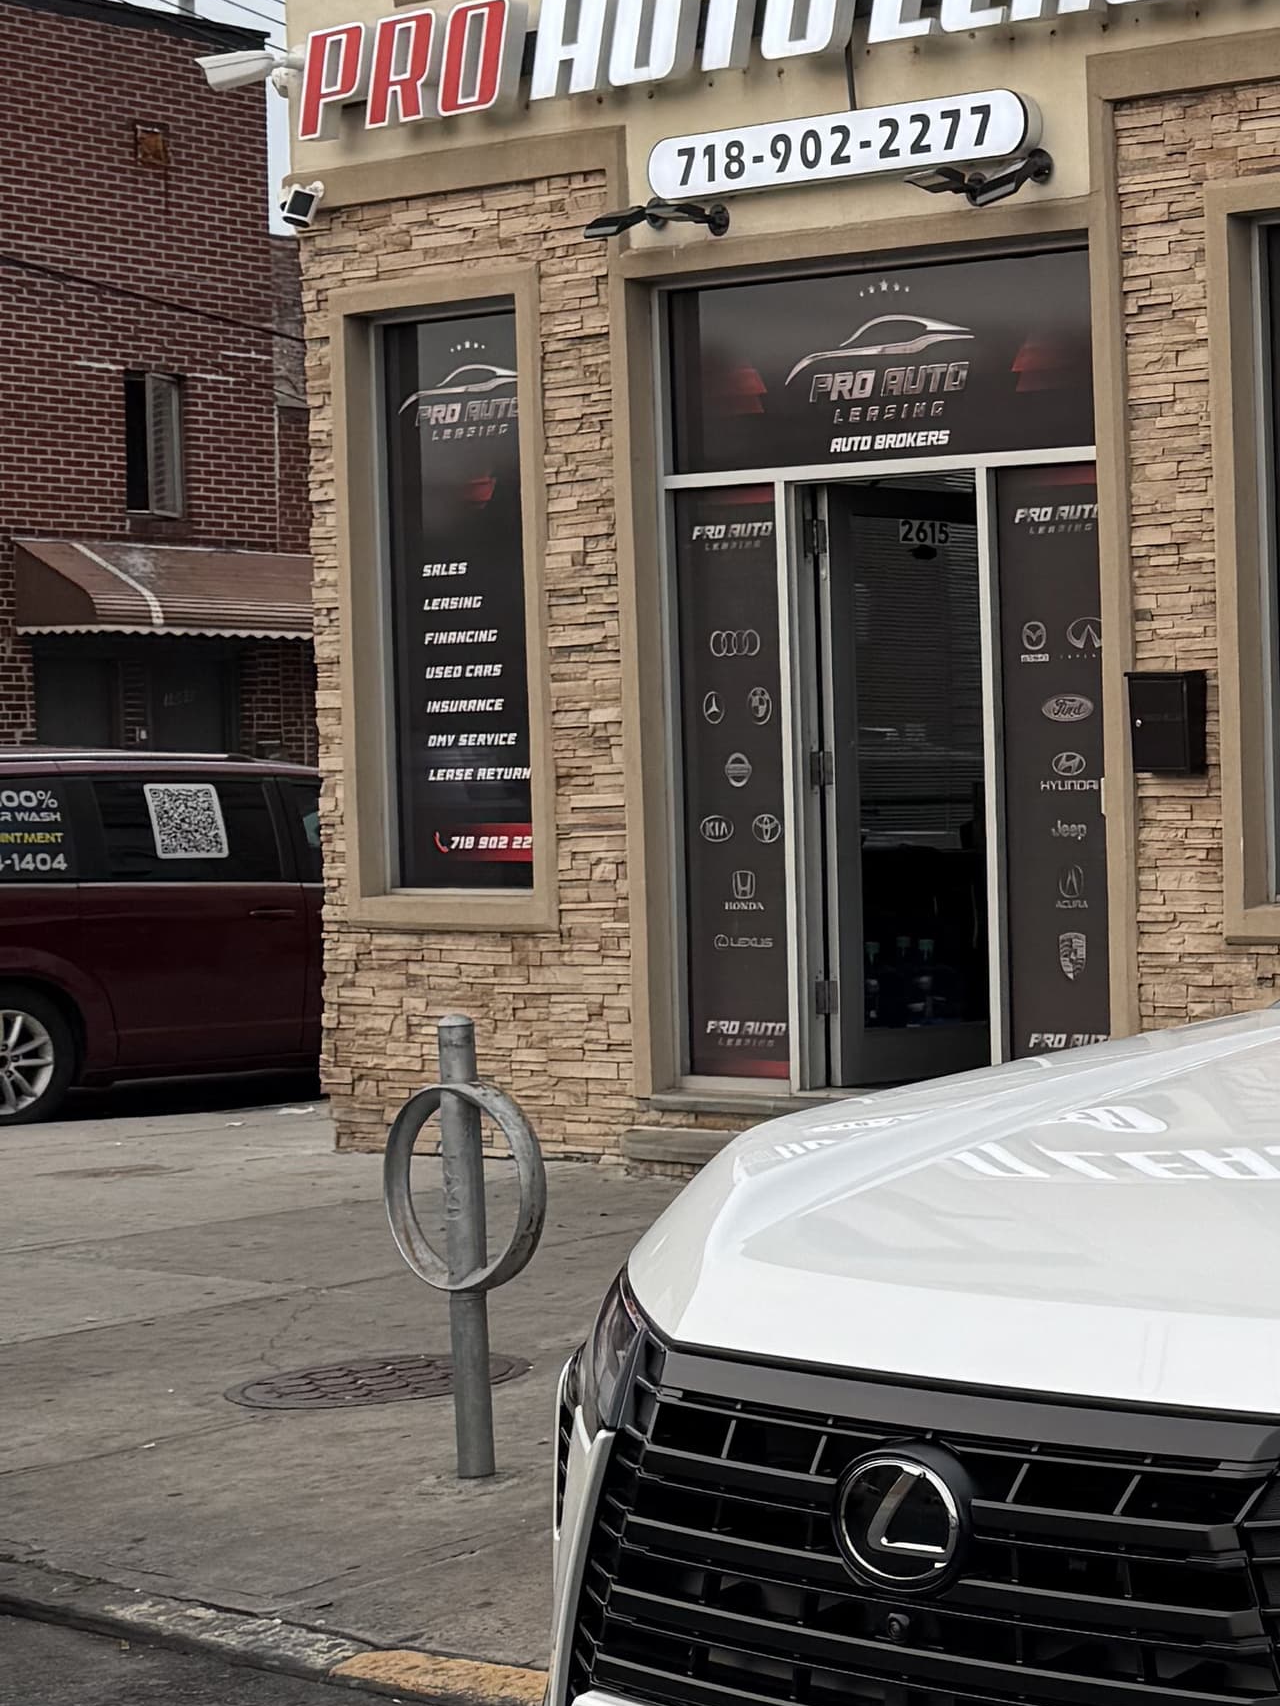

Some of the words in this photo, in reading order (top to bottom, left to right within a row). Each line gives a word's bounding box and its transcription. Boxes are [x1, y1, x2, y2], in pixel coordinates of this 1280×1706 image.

[676, 104, 993, 186] 718-902-2277
[809, 369, 876, 403] PRO
[880, 361, 970, 397] AUTO
[415, 403, 461, 426] PRO
[833, 400, 945, 424] LEASING
[432, 424, 508, 441] LEASING
[829, 435, 872, 453] AUTO
[874, 429, 950, 451] BROKERS
[1015, 506, 1053, 524] PRO
[692, 524, 725, 540] PRO
[728, 521, 773, 539] AUTO
[901, 520, 949, 543] 2615
[422, 562, 467, 577] SALES
[423, 596, 482, 611] LEASING
[424, 629, 498, 645] FINANCING
[426, 665, 462, 679] USED
[465, 664, 502, 678] CARS
[427, 699, 504, 713] INSURANCE
[428, 734, 455, 747] DMV
[458, 733, 517, 746] SERVICE
[428, 768, 473, 781] LEASE
[1040, 779, 1099, 791] HYUNDAI
[0, 790, 58, 808] 00%
[14, 812, 61, 822] WASH
[705, 819, 729, 837] KIA
[1051, 820, 1087, 840] Jeep
[450, 836, 474, 849] 718
[478, 836, 508, 849] 902
[724, 901, 764, 911] HONDA
[1055, 899, 1088, 909] ACURA
[730, 938, 773, 948] LEXUS
[706, 1020, 739, 1034] PRO
[742, 1021, 787, 1036] AUTO
[1028, 1033, 1067, 1048] PRO
